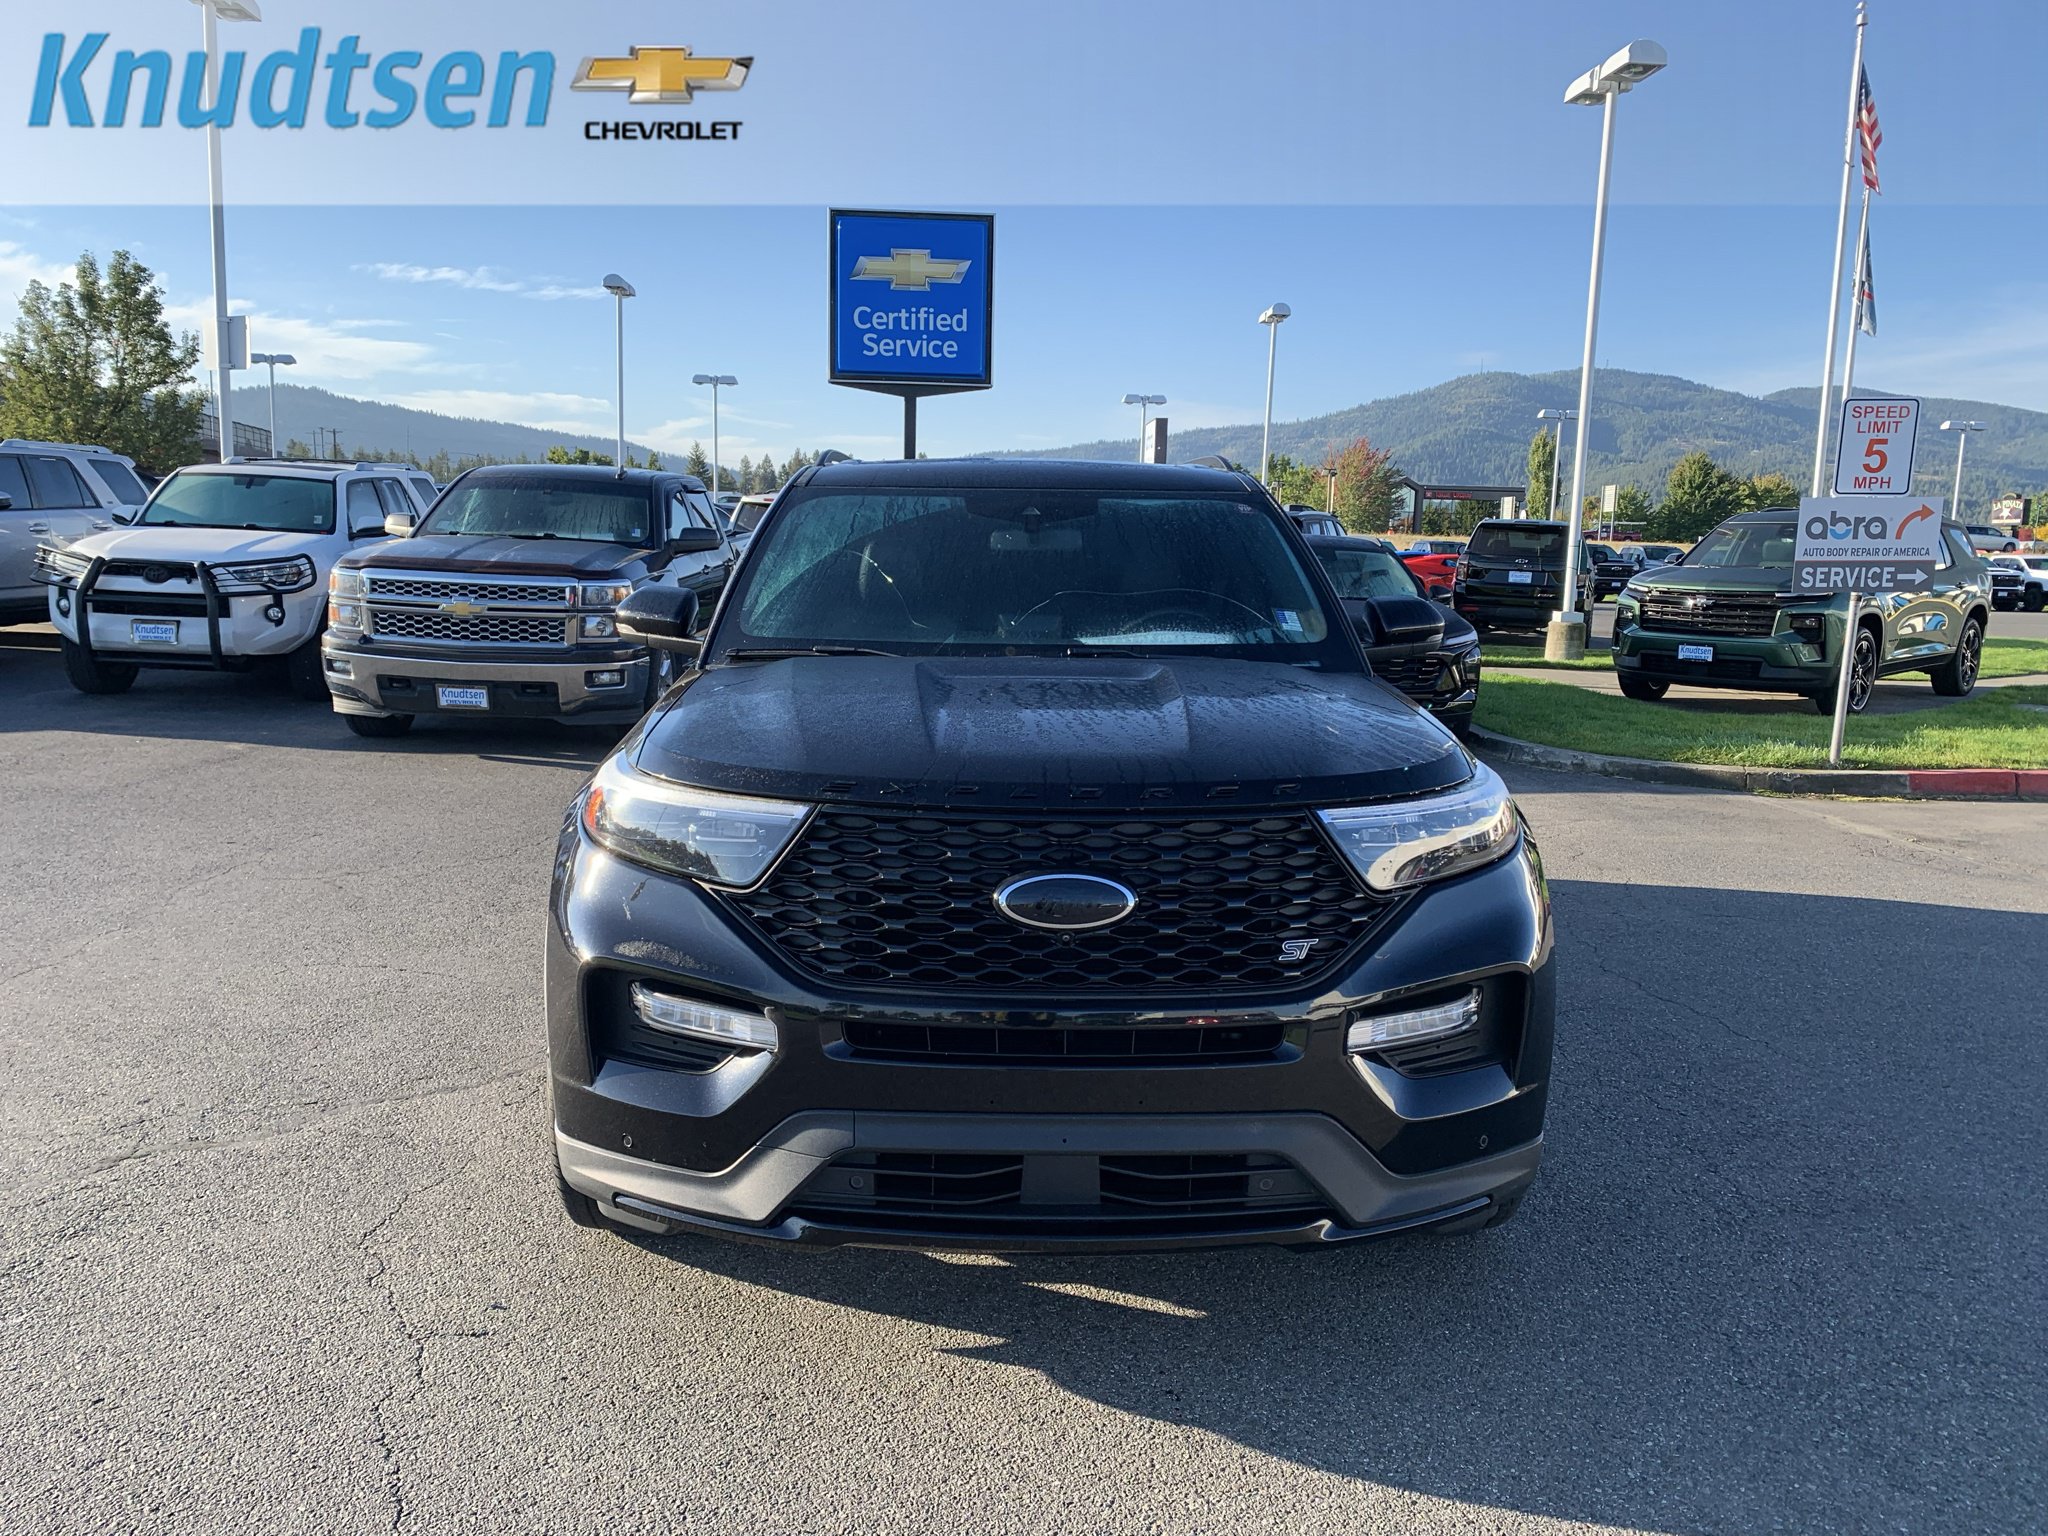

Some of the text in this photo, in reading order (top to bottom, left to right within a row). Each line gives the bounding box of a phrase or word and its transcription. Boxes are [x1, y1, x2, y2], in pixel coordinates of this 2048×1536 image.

[853, 306, 968, 332] Certified
[862, 333, 959, 359] Service
[1851, 405, 1911, 419] SPEED
[1856, 420, 1903, 434] LIMIT
[1862, 438, 1889, 474] 5
[1853, 476, 1892, 489] MPH
[1805, 510, 1888, 540] abra
[1802, 547, 1931, 557] AUTO BODY REPAIR OF AMERICA
[1800, 566, 1896, 588] SERVICE
[134, 624, 174, 635] Knudtsen
[441, 688, 485, 699] Knudtsen
[819, 780, 1304, 800] EXPLORER
[1278, 938, 1320, 961] ST
